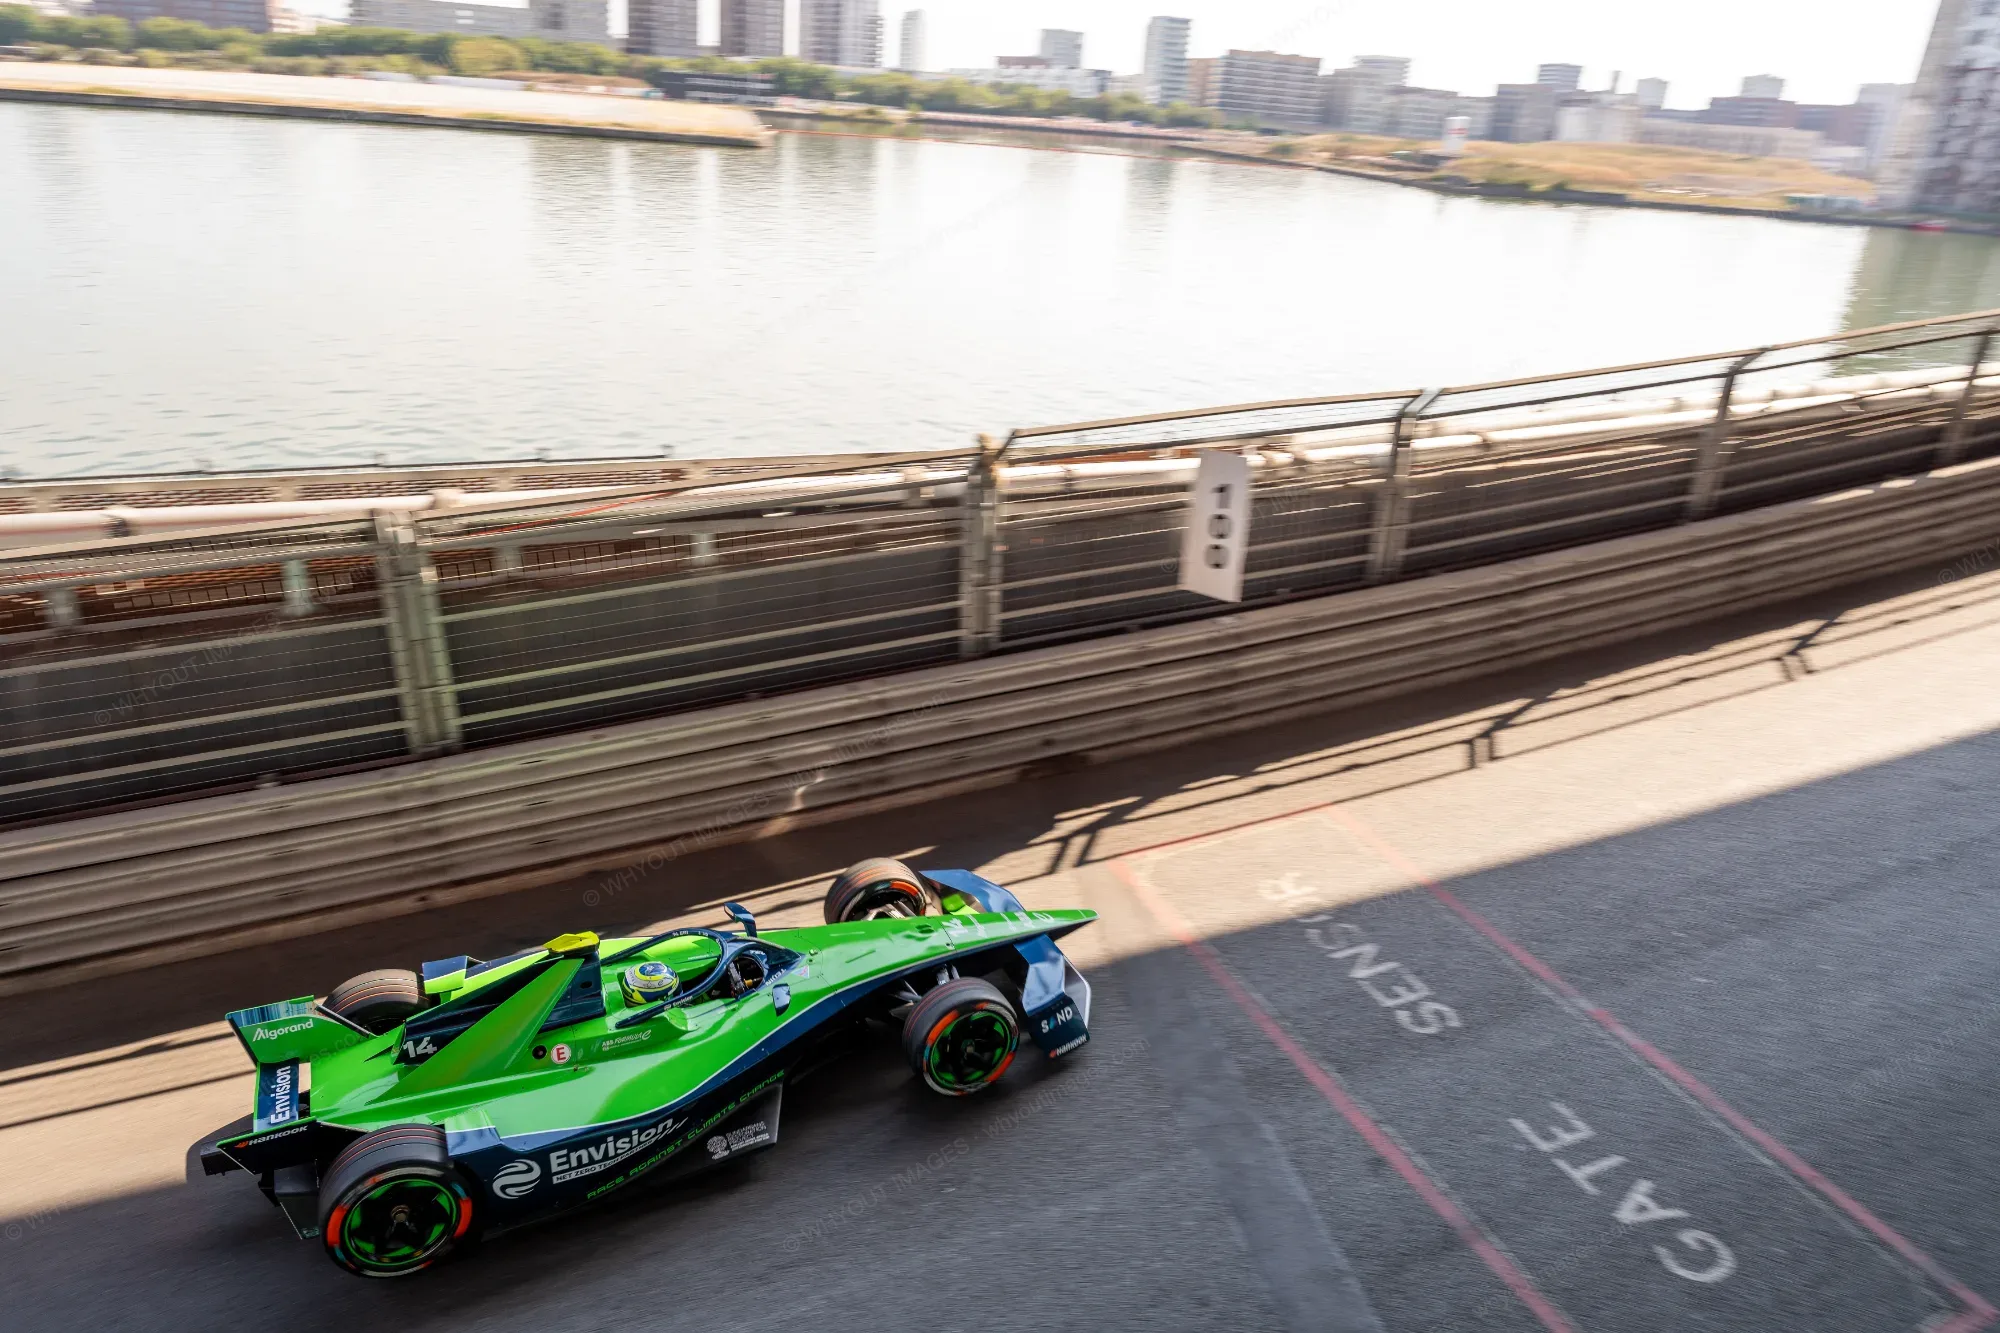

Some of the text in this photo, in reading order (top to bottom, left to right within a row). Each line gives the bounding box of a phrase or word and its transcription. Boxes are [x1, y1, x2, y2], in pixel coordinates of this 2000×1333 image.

[1203, 483, 1235, 570] 100
[252, 1018, 314, 1042] Algorand
[402, 1036, 438, 1059] 14
[555, 1046, 567, 1061] E
[270, 1065, 291, 1124] Envision
[549, 1117, 674, 1174] Envision
[587, 1175, 625, 1200] RACE
[629, 1138, 683, 1176] AGAINST
[687, 1102, 736, 1139] CLIMATE
[739, 1069, 785, 1103] CHANGE
[556, 1172, 573, 1182] NET
[574, 1165, 597, 1178] ZERO
[1509, 1101, 1737, 1284] GATE
